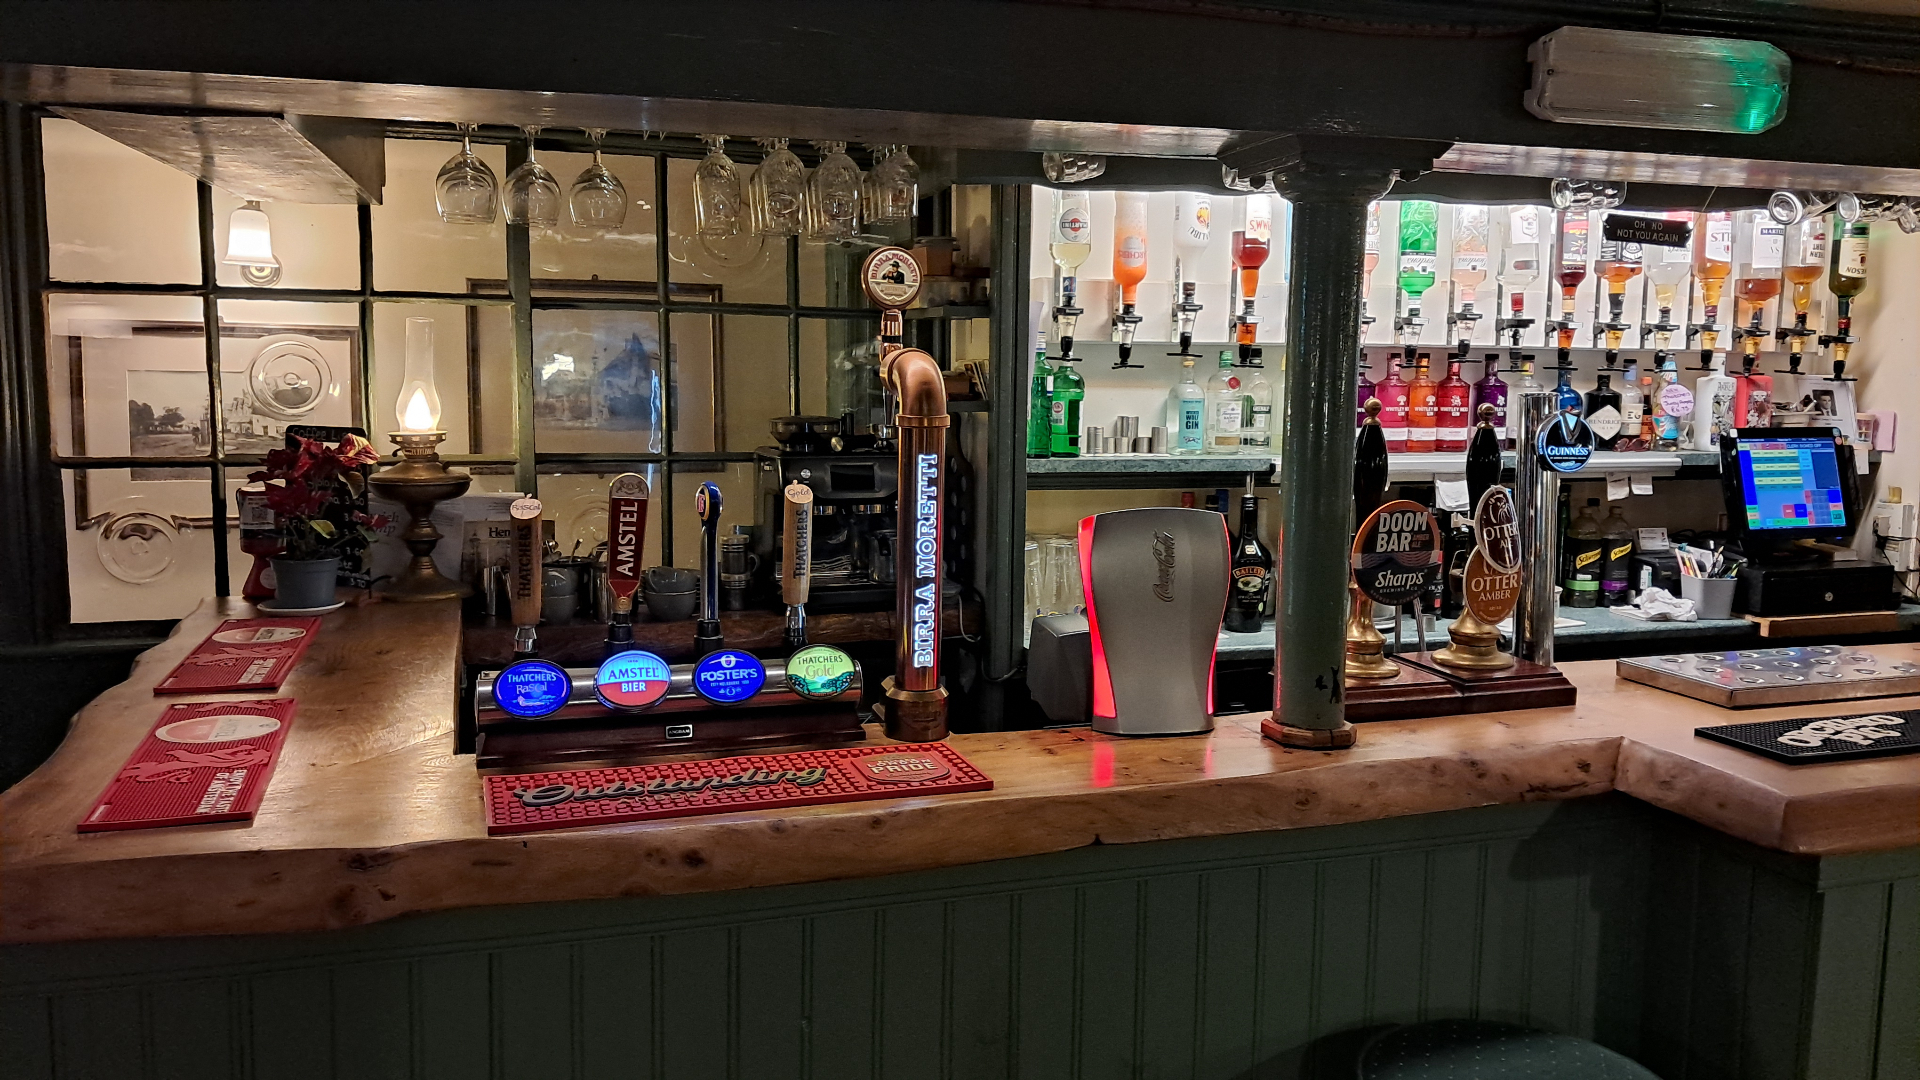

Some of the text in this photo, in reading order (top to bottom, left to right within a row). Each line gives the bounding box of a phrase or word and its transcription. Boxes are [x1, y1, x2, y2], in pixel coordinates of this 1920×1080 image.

[1634, 220, 1663, 230] OH NO
[1617, 229, 1679, 243] NOT YOU AGAIN
[870, 253, 918, 283] BIRRA MORETTI
[1186, 421, 1199, 430] GIN
[1548, 446, 1591, 456] GUINNESS
[787, 487, 810, 498] Gold
[1379, 512, 1428, 532] DOOM
[488, 526, 511, 538] Hen
[1485, 522, 1518, 540] OTTER
[616, 501, 637, 577] AMSTEL
[793, 508, 809, 580] THATCHERS
[1376, 533, 1411, 552] BAR
[517, 525, 532, 600] THATCHERS
[914, 454, 937, 668] BIRRA MORETTI
[1152, 528, 1175, 602] Coca-Cola
[1236, 566, 1265, 578] BAILEYS
[1375, 570, 1424, 589] Sharp's
[1471, 574, 1518, 592] OTTER
[1480, 590, 1511, 601] AMBER
[797, 655, 843, 665] THATCHERS
[507, 672, 557, 683] THATCHERS
[608, 667, 659, 681] AMSTEL
[701, 668, 758, 682] FOSTER'S
[805, 664, 835, 679] Gold
[621, 682, 646, 693] BIER
[1777, 715, 1905, 747] ORCHARD
[1832, 726, 1901, 745] PIG
[867, 758, 931, 768] LONDON
[871, 763, 939, 774] PRIDE
[514, 766, 827, 807] Outstanding
